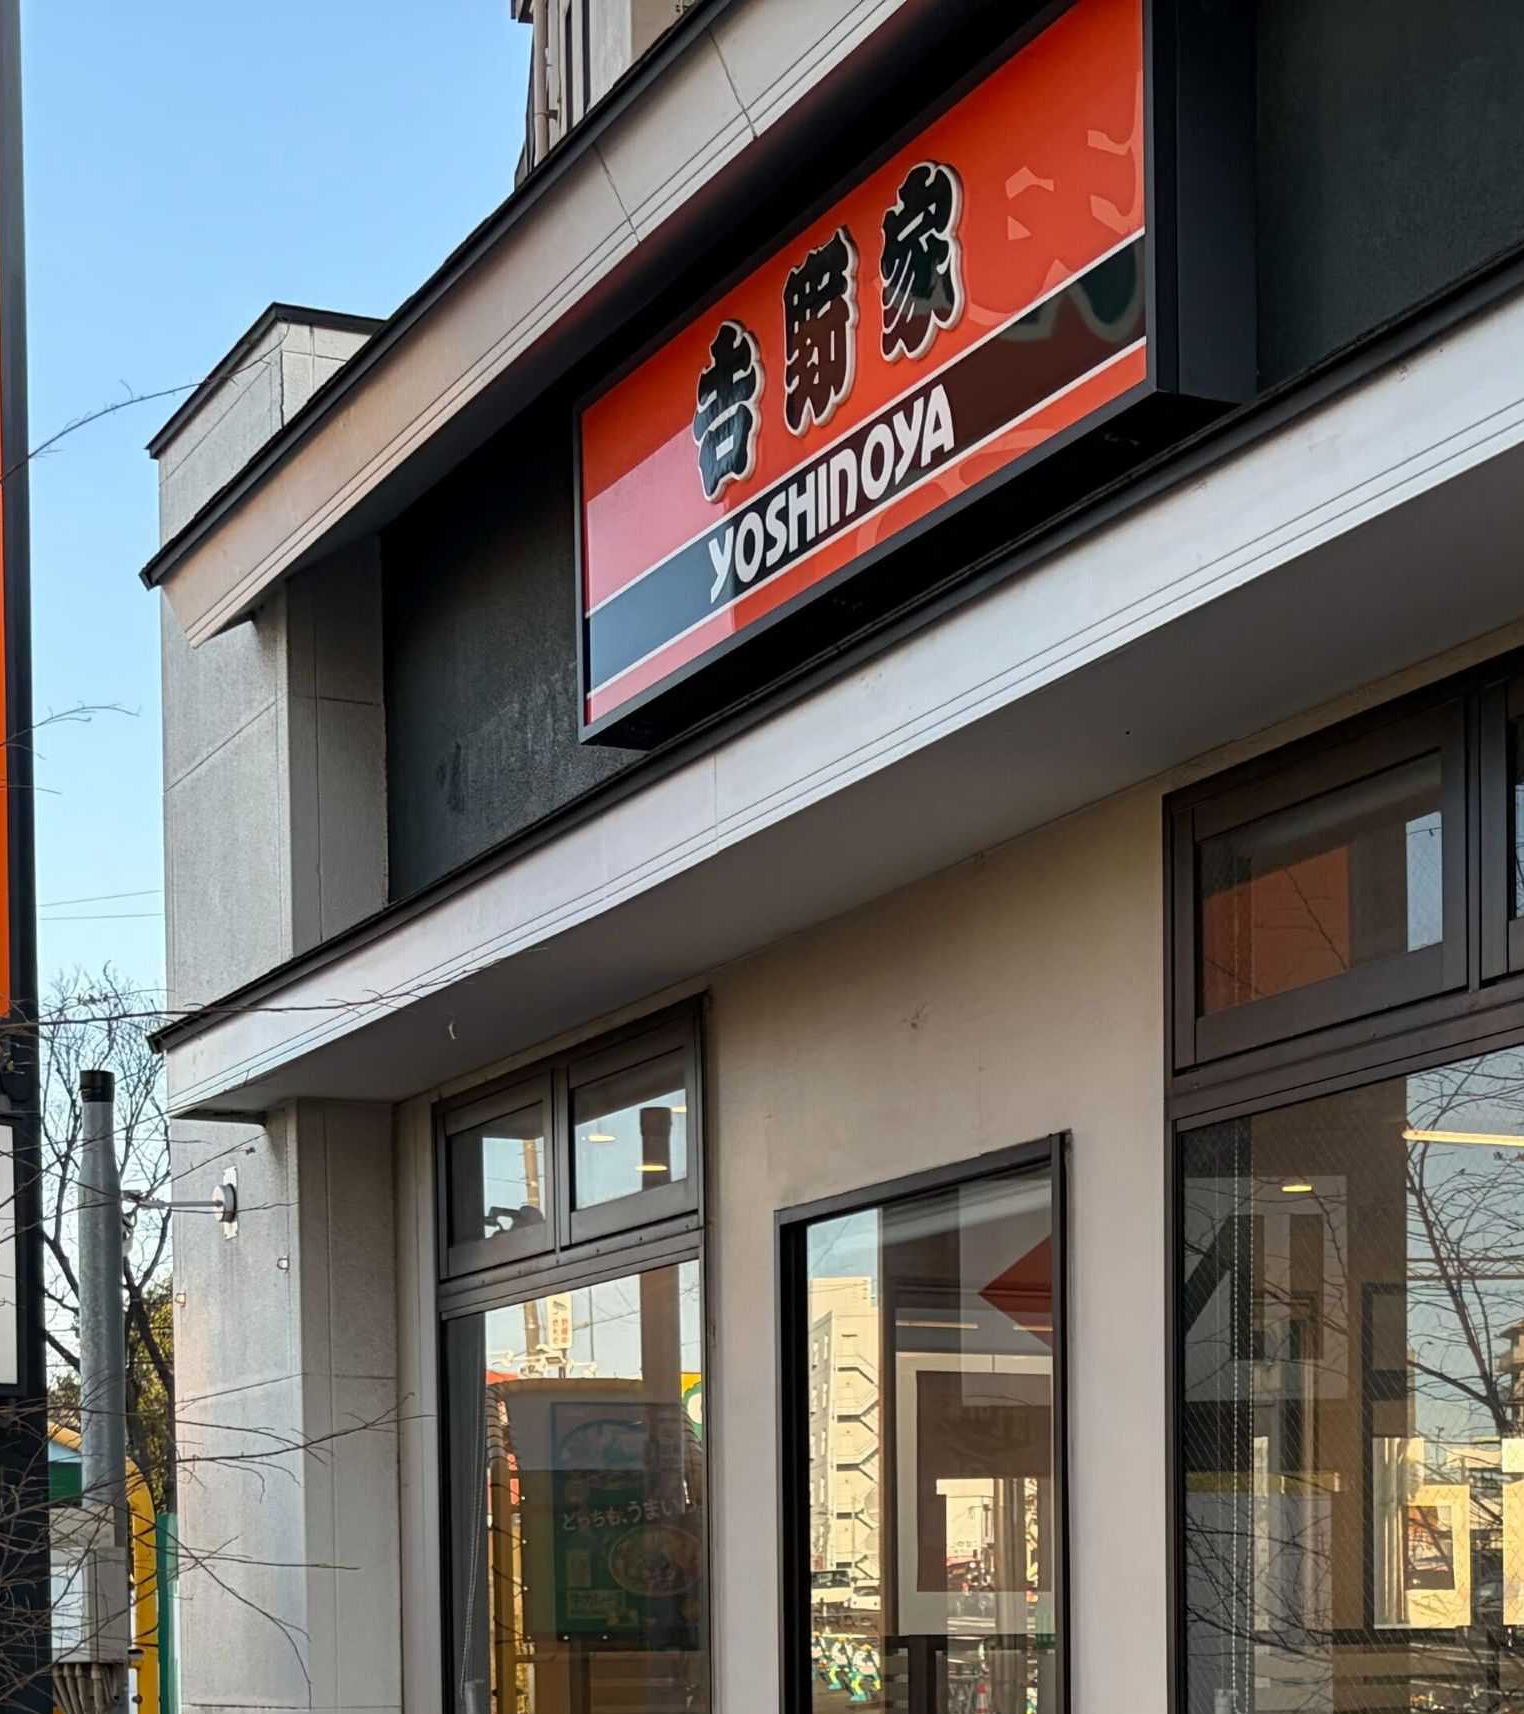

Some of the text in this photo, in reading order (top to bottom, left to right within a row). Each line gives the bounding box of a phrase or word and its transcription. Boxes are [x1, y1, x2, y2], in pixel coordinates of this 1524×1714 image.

[692, 160, 964, 503] 吉野家
[708, 383, 955, 604] YOSHINOYA
